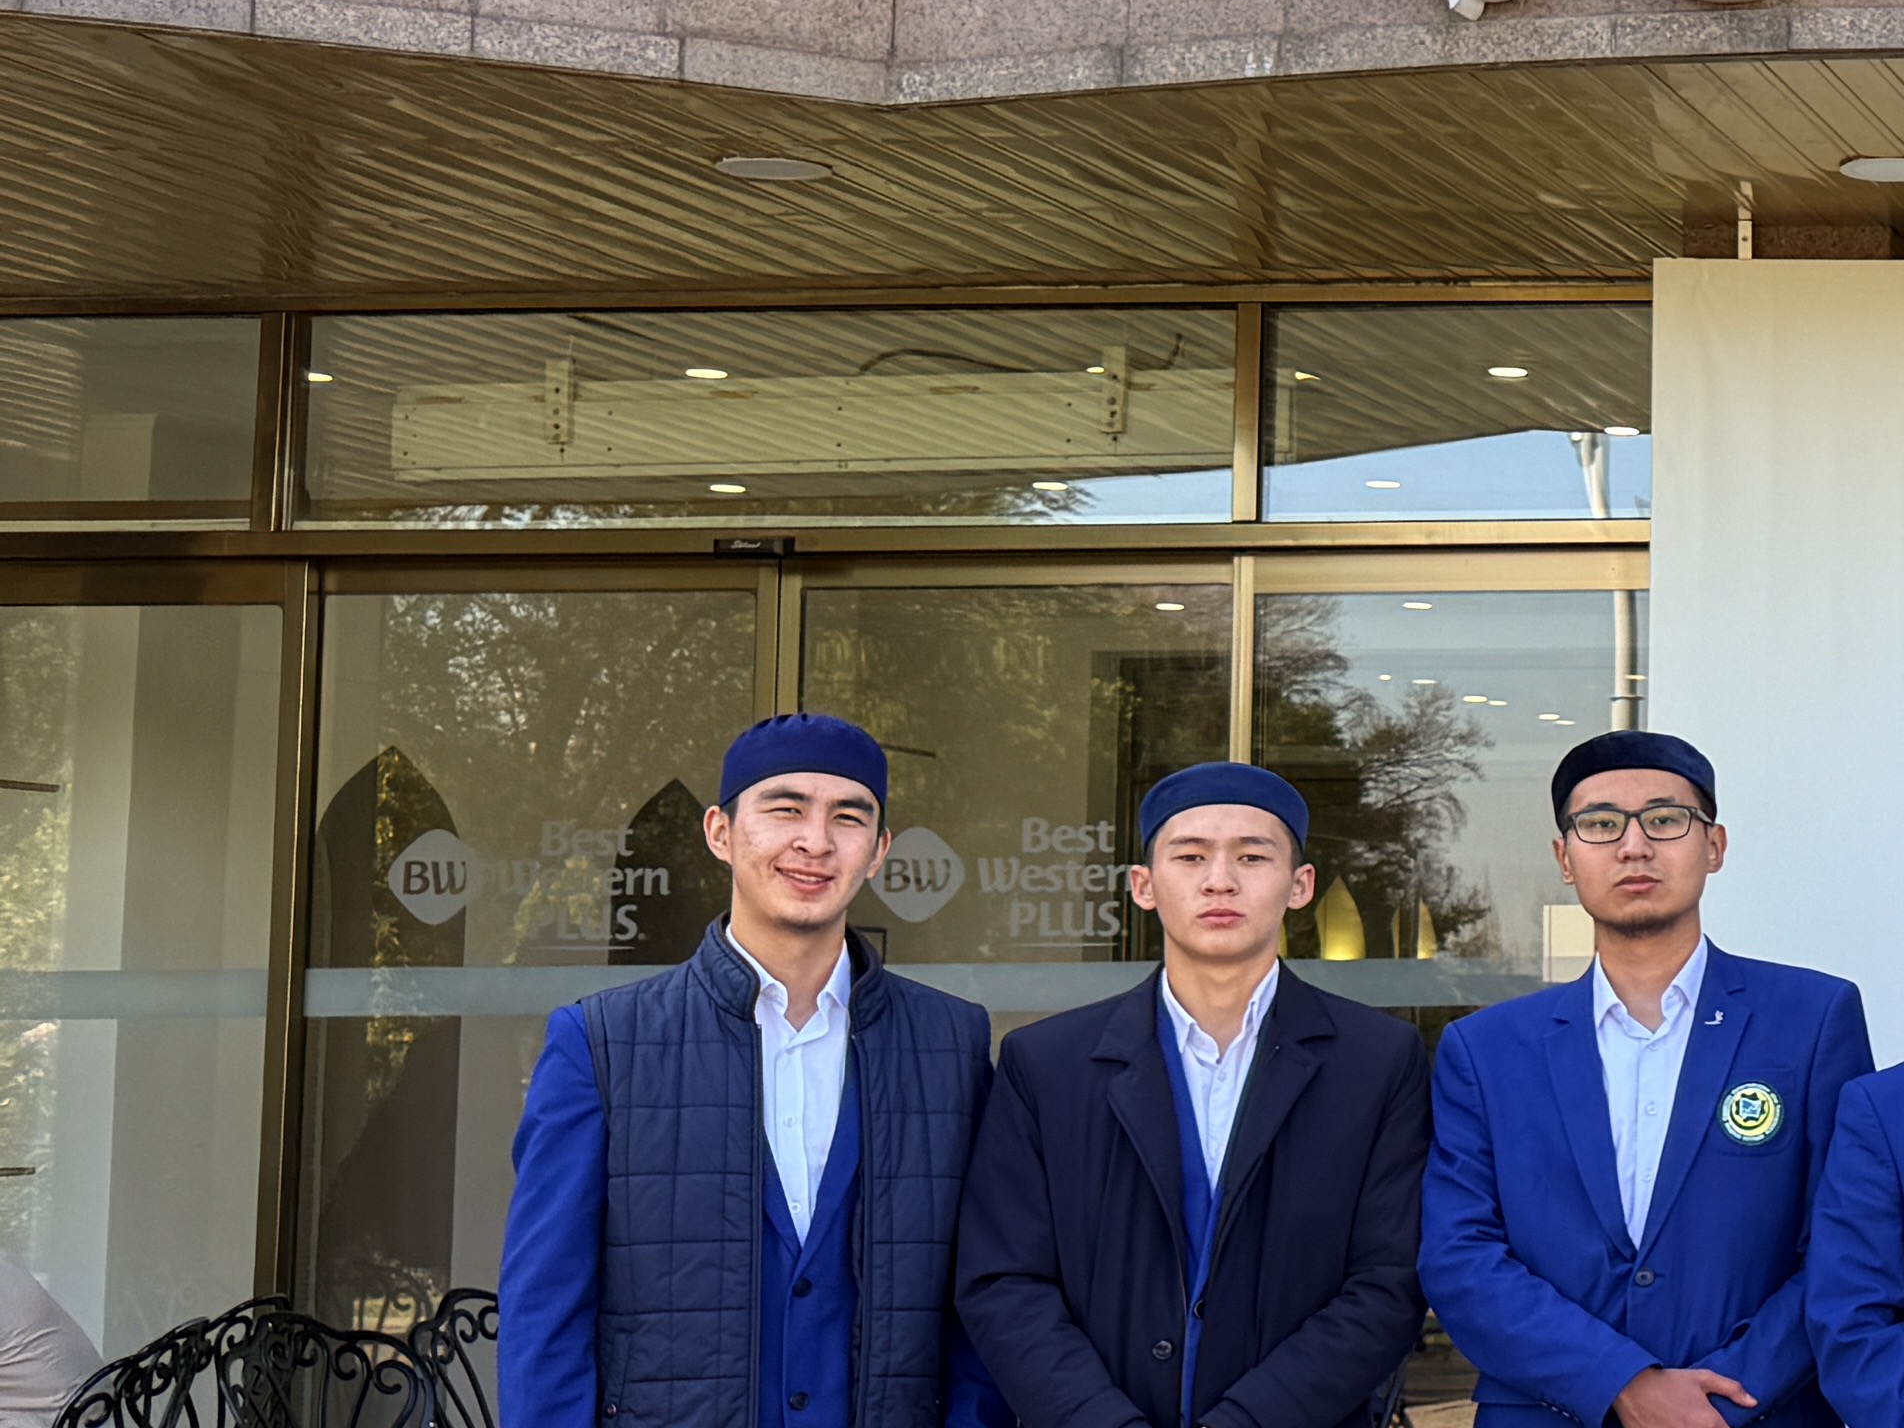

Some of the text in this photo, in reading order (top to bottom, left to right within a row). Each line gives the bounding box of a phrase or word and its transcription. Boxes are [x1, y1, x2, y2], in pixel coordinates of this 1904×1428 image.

[540, 820, 635, 857] Best
[1020, 816, 1116, 853] Best
[401, 860, 468, 896] BW
[883, 858, 950, 894] BW
